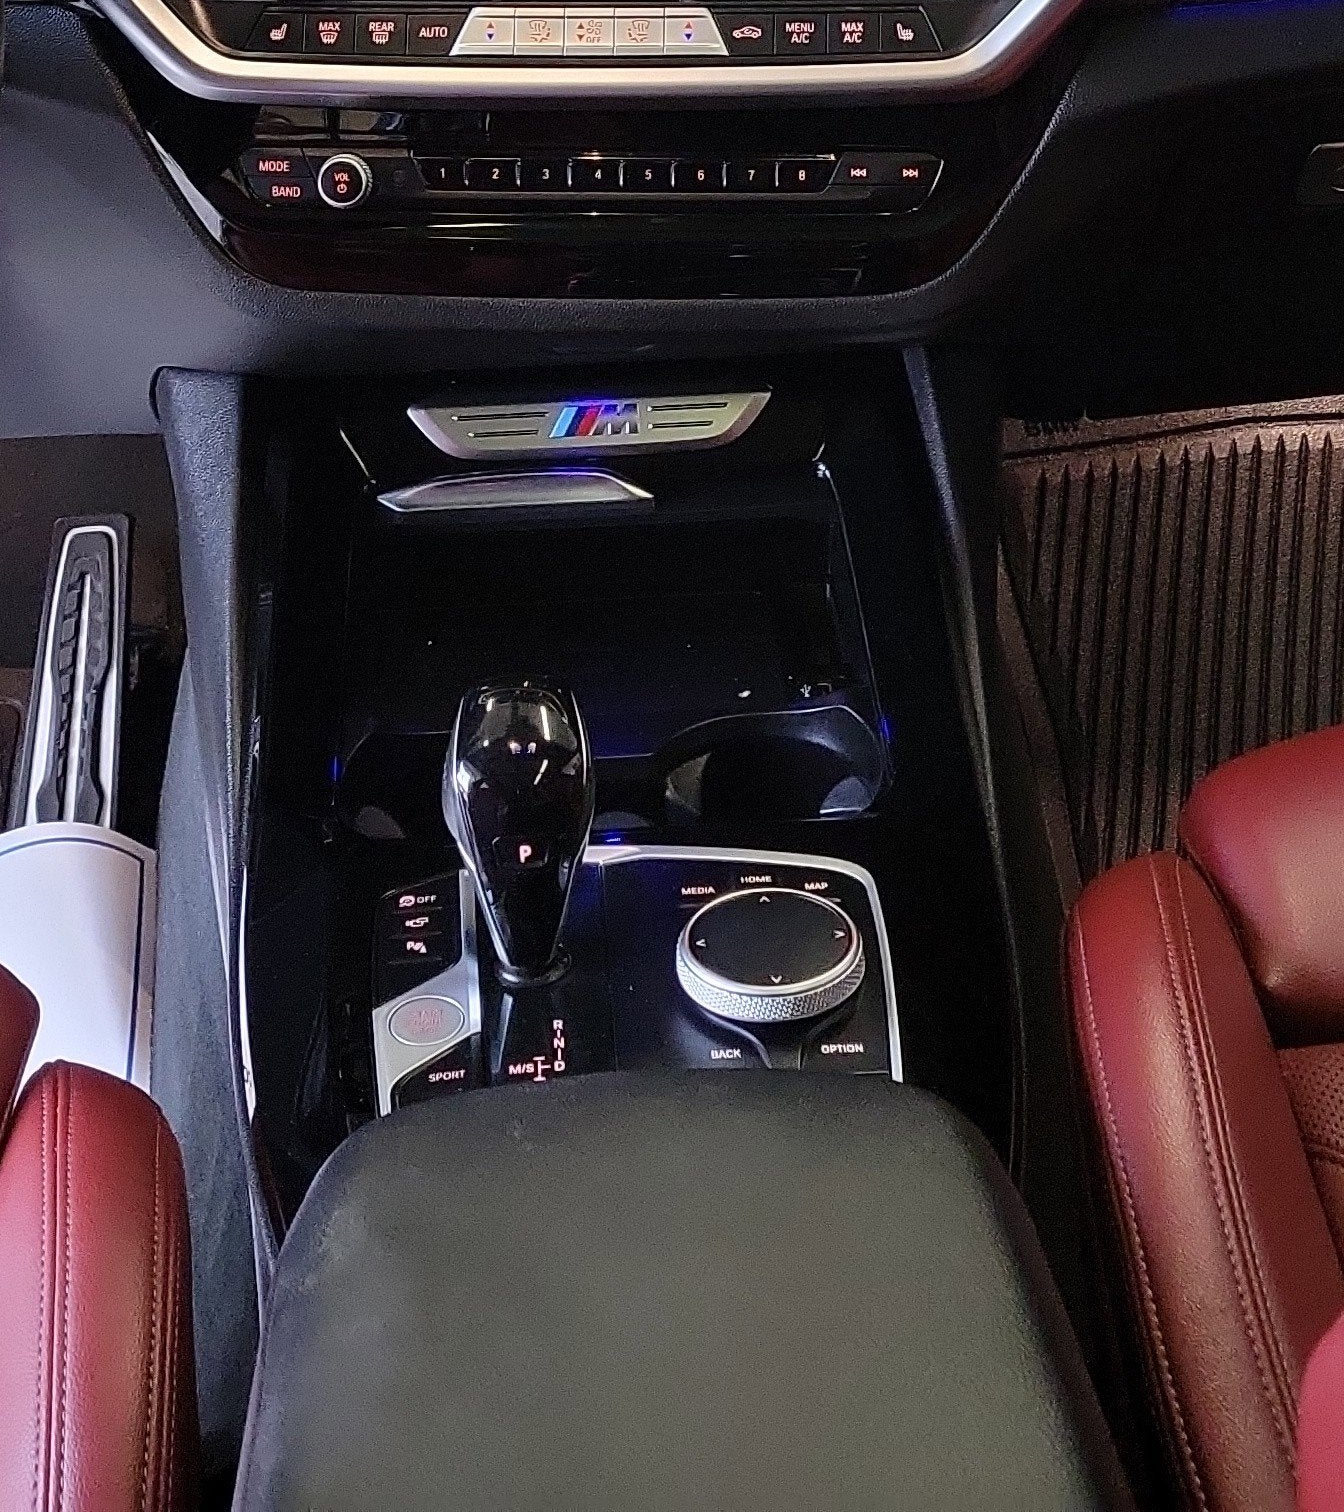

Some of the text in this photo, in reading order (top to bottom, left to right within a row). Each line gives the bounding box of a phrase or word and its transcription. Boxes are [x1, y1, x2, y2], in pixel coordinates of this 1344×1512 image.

[318, 21, 342, 33] MAX
[368, 21, 395, 33] REAR
[419, 24, 448, 39] AUTO
[785, 21, 815, 33] MENU
[841, 21, 864, 33] MAX
[791, 32, 810, 45] A/C
[843, 32, 862, 45] A/C
[259, 159, 291, 173] MODE
[333, 171, 350, 182] VOL
[440, 167, 446, 180] 1
[492, 168, 500, 180] 2
[542, 169, 550, 180] 3
[594, 169, 602, 180] 4
[645, 169, 653, 181] 5
[697, 169, 705, 181] 6
[748, 169, 755, 181] 7
[271, 184, 301, 199] BAND
[519, 844, 532, 864] P
[740, 875, 772, 884] HOME
[681, 886, 715, 896] MEDIA
[804, 882, 828, 891] MAP
[416, 894, 437, 904] OFF
[553, 1019, 563, 1030] R
[553, 1038, 565, 1049] N
[820, 1043, 864, 1055] OPTION
[711, 1048, 741, 1060] BACK
[508, 1062, 534, 1076] M/S
[554, 1061, 565, 1072] D
[428, 1069, 466, 1083] SPORT
